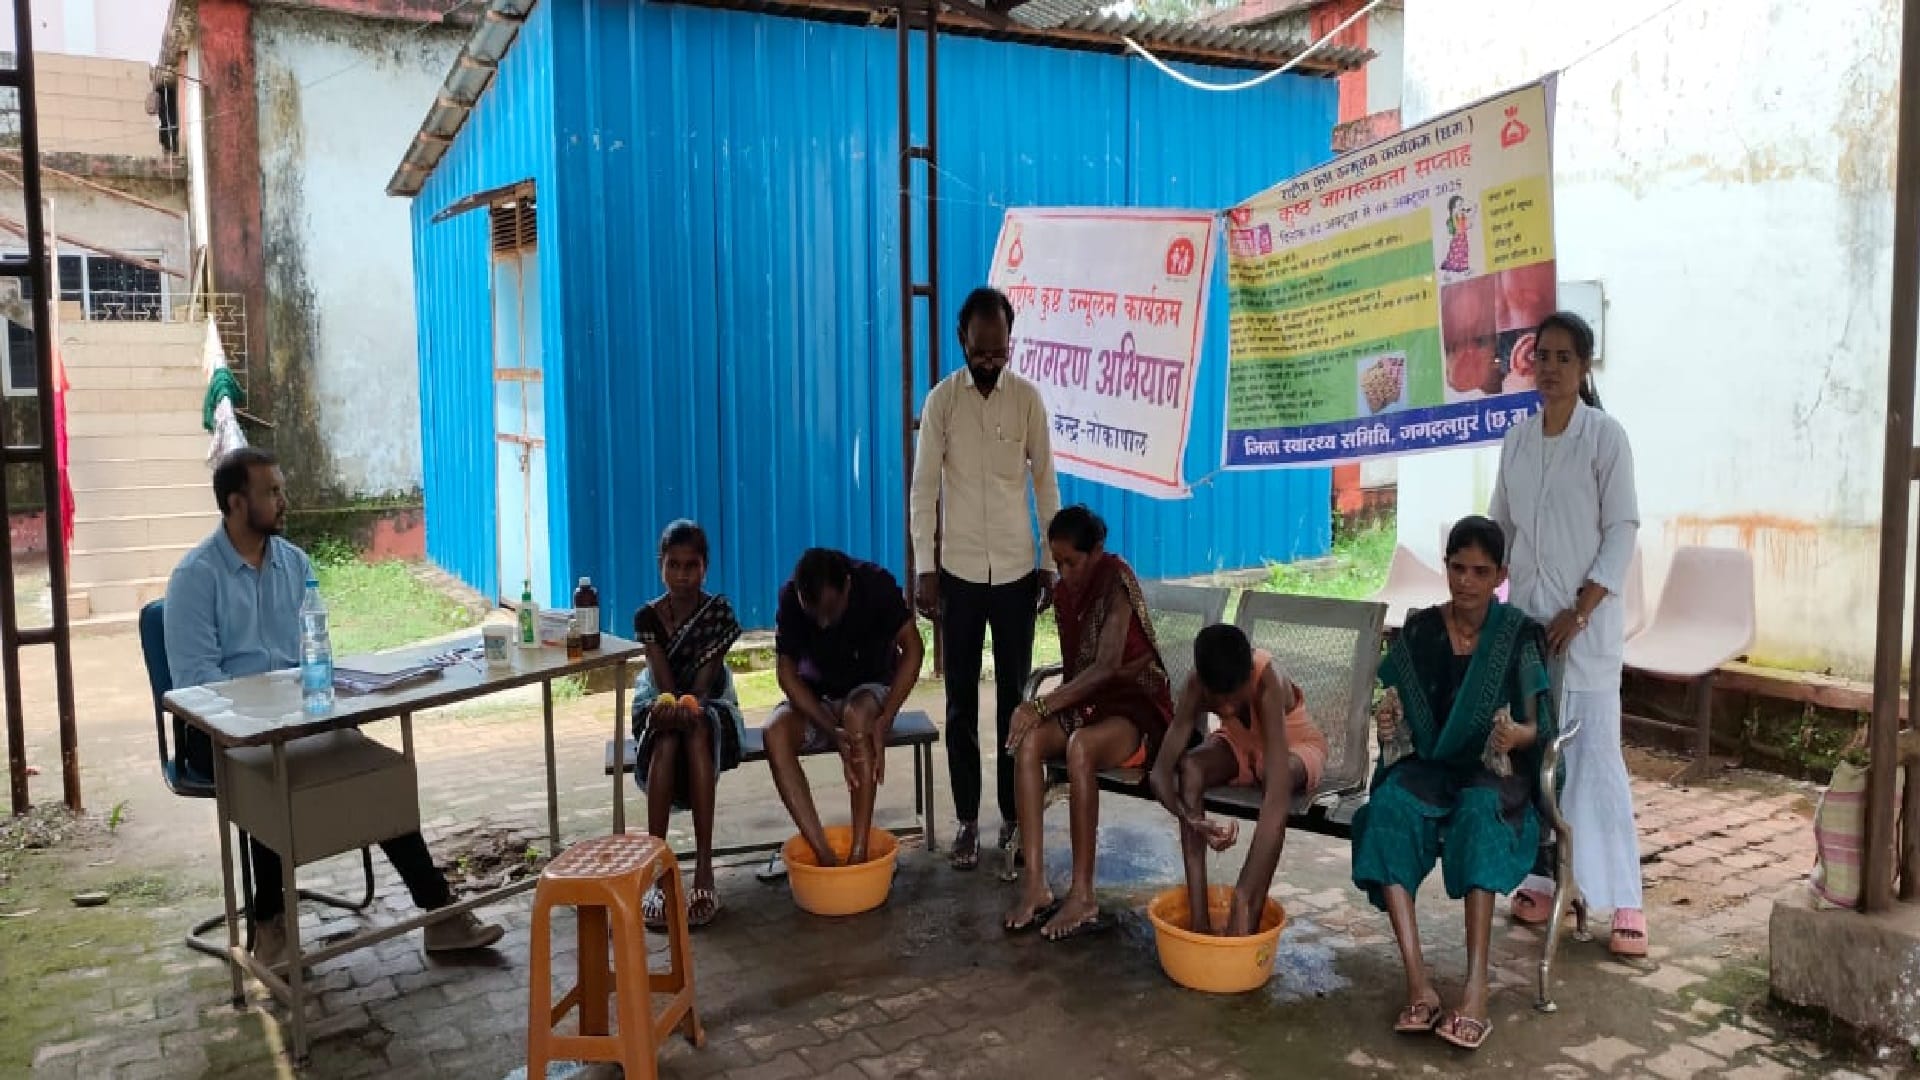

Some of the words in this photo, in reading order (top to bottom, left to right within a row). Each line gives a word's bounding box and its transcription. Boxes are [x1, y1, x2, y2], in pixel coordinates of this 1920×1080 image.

[1414, 143, 1471, 179] सप्ताह
[1069, 288, 1119, 327] उन्मूलन
[1124, 284, 1183, 328] कार्यक्रम
[1020, 338, 1093, 391] जागरण
[1096, 330, 1186, 409] अभियान
[1245, 437, 1280, 457] जिला
